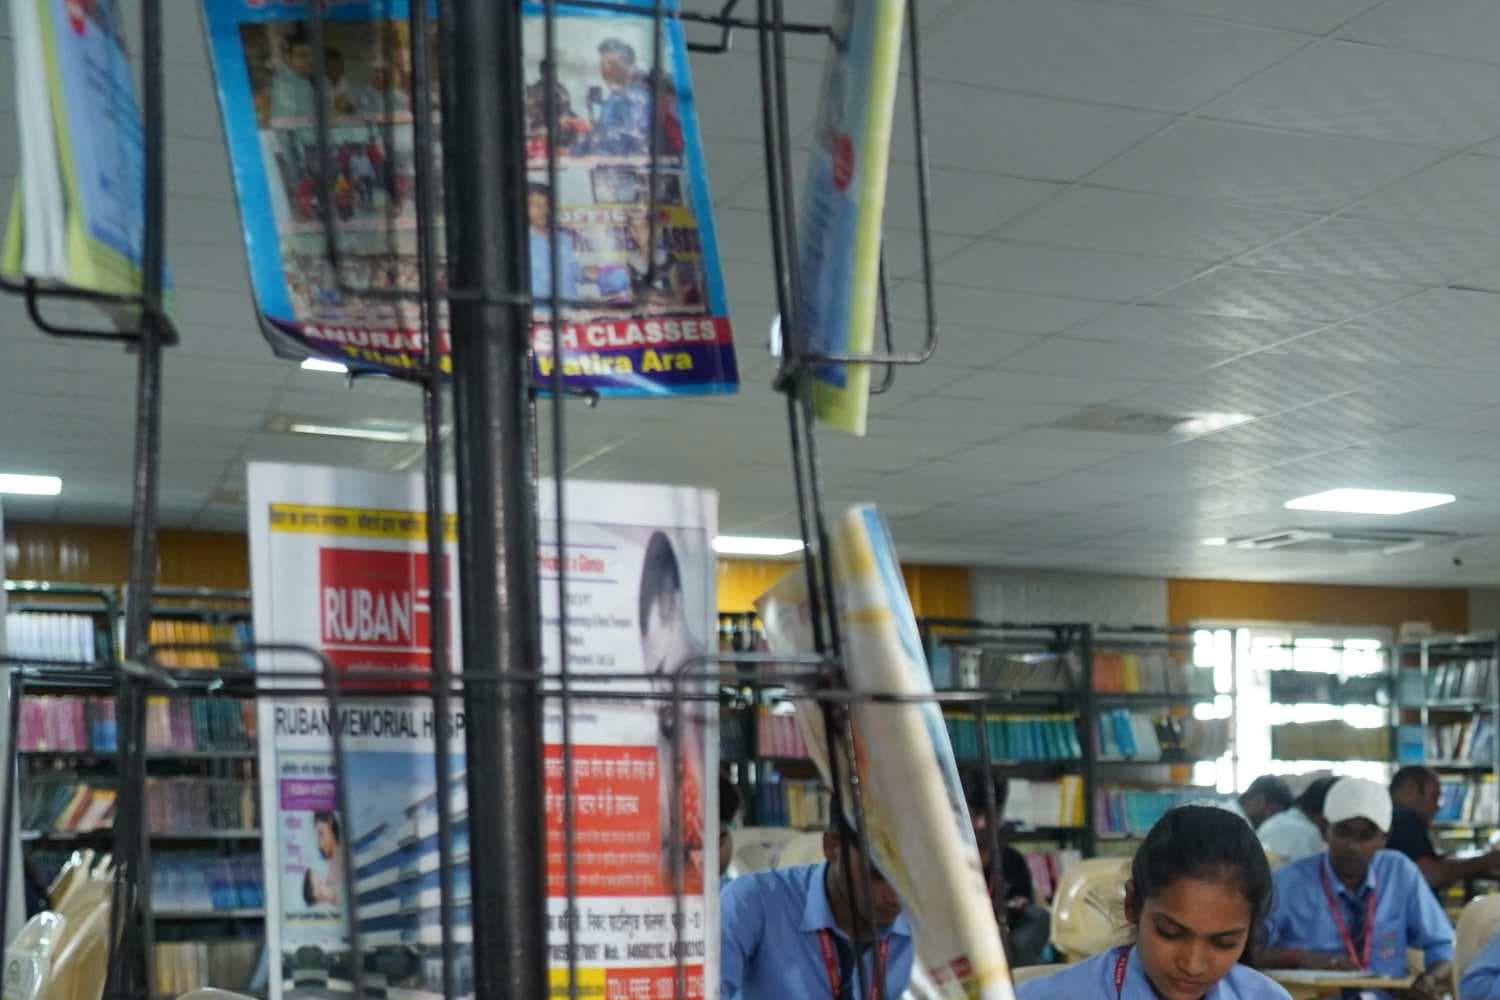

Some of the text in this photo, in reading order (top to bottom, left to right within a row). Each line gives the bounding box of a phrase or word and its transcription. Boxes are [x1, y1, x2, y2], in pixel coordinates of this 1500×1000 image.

[586, 320, 717, 347] CLASSES
[641, 349, 693, 373] Ara
[323, 587, 412, 641] RUBAN
[275, 706, 333, 736] RUBAN
[336, 708, 419, 738] MEMORIAL
